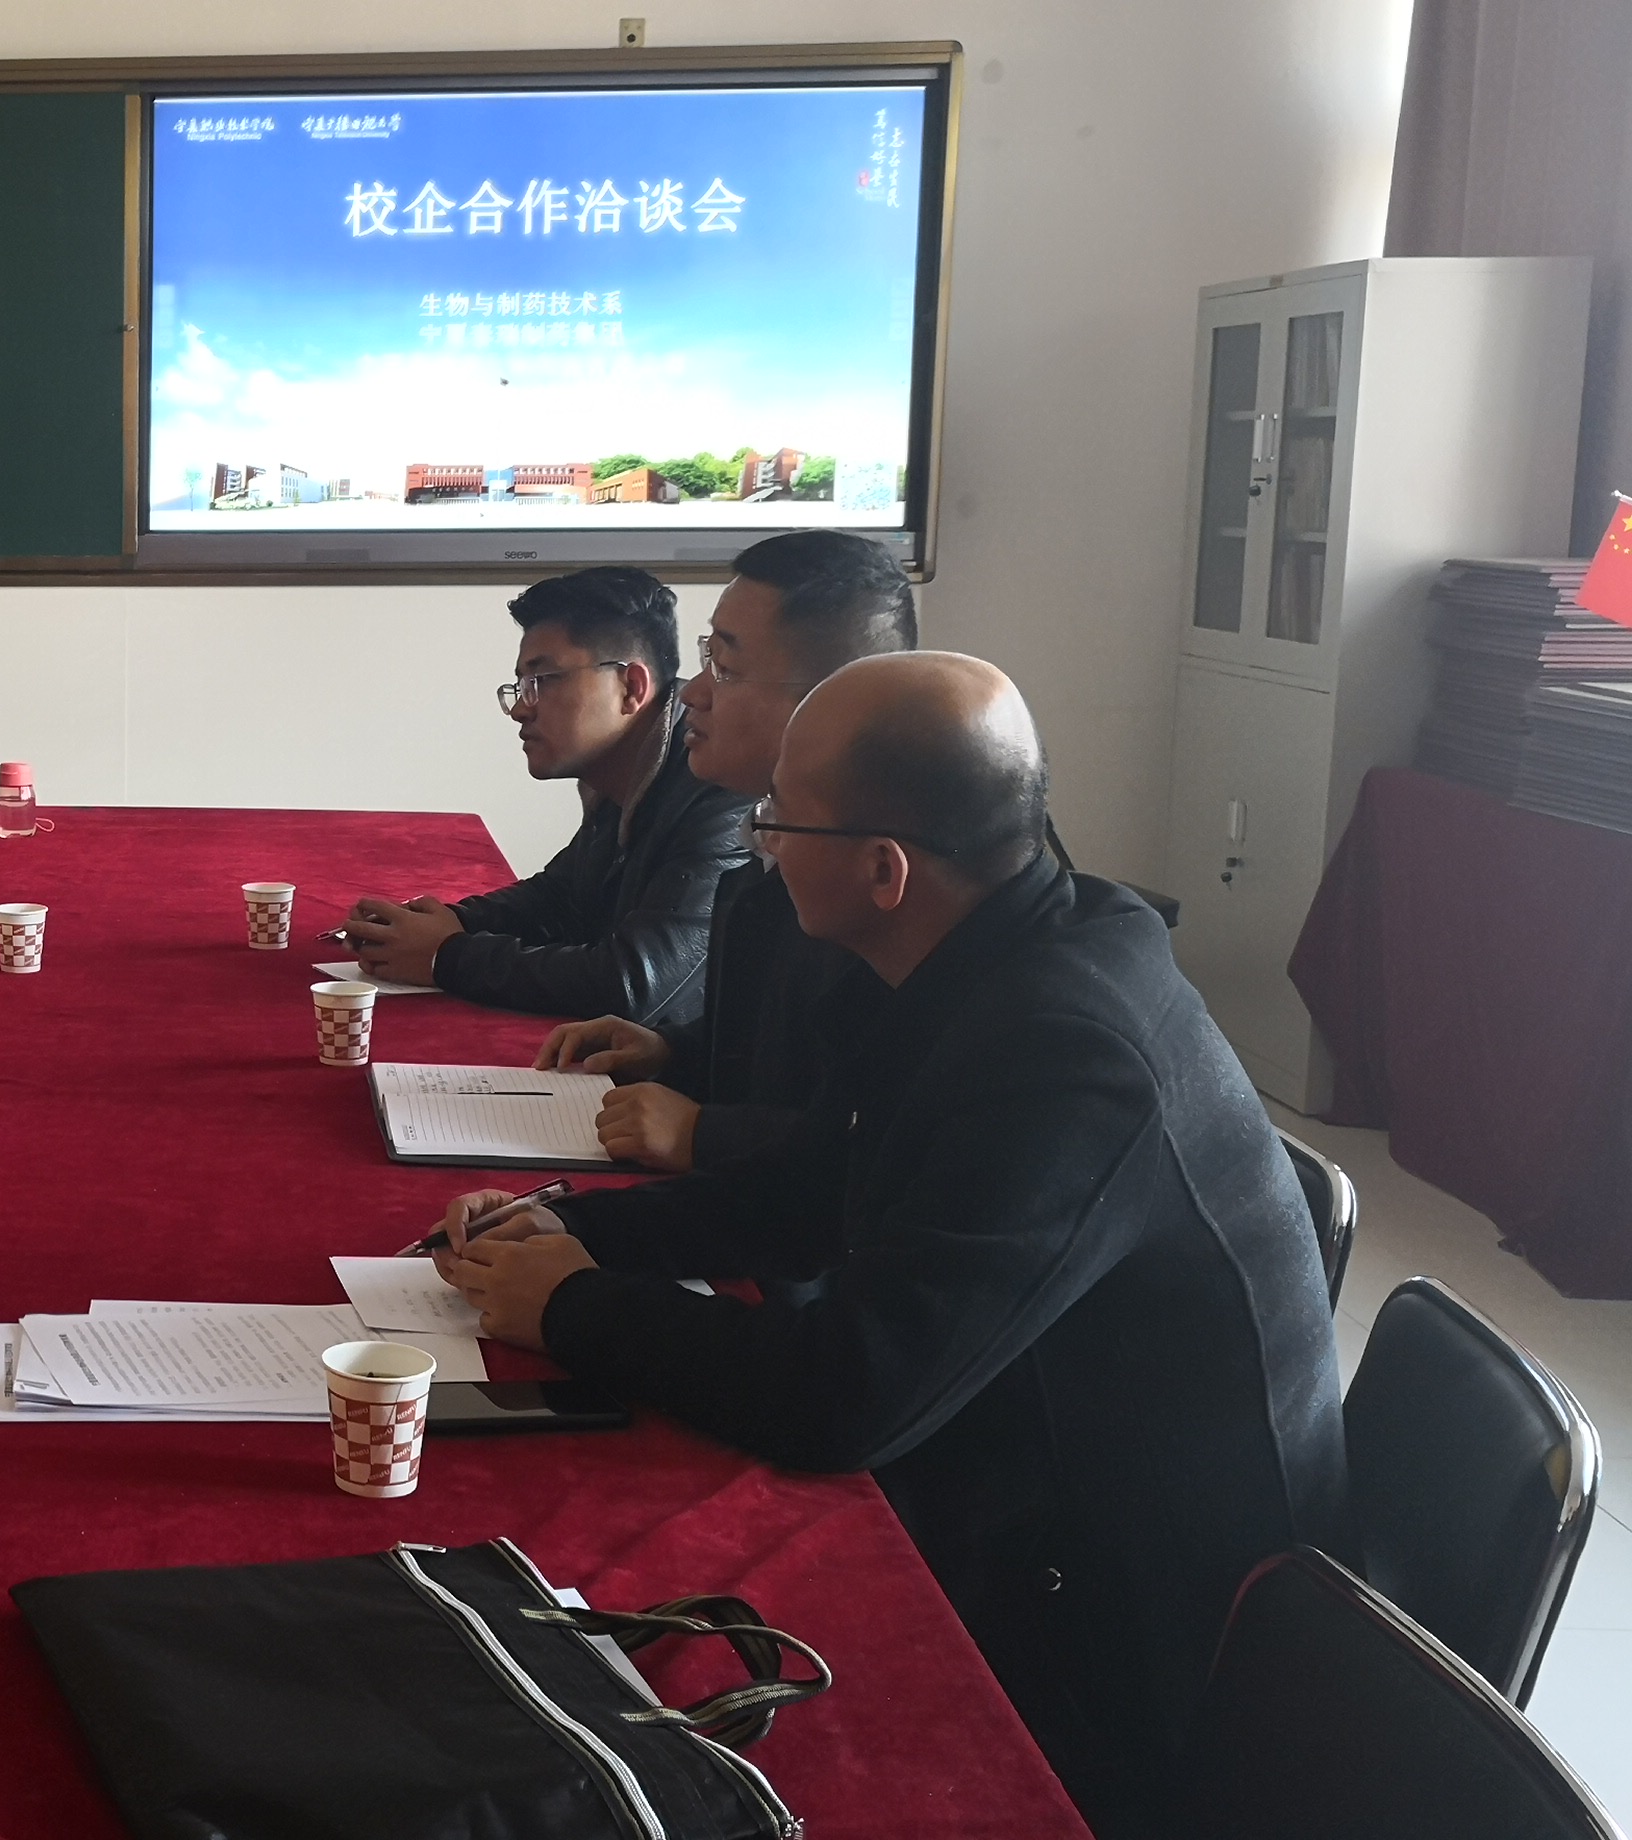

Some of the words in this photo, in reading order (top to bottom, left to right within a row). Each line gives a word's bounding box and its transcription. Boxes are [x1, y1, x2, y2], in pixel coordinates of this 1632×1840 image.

[344, 176, 746, 237] 校企合作洽谈会
[419, 291, 623, 317] 生物与制药技术系
